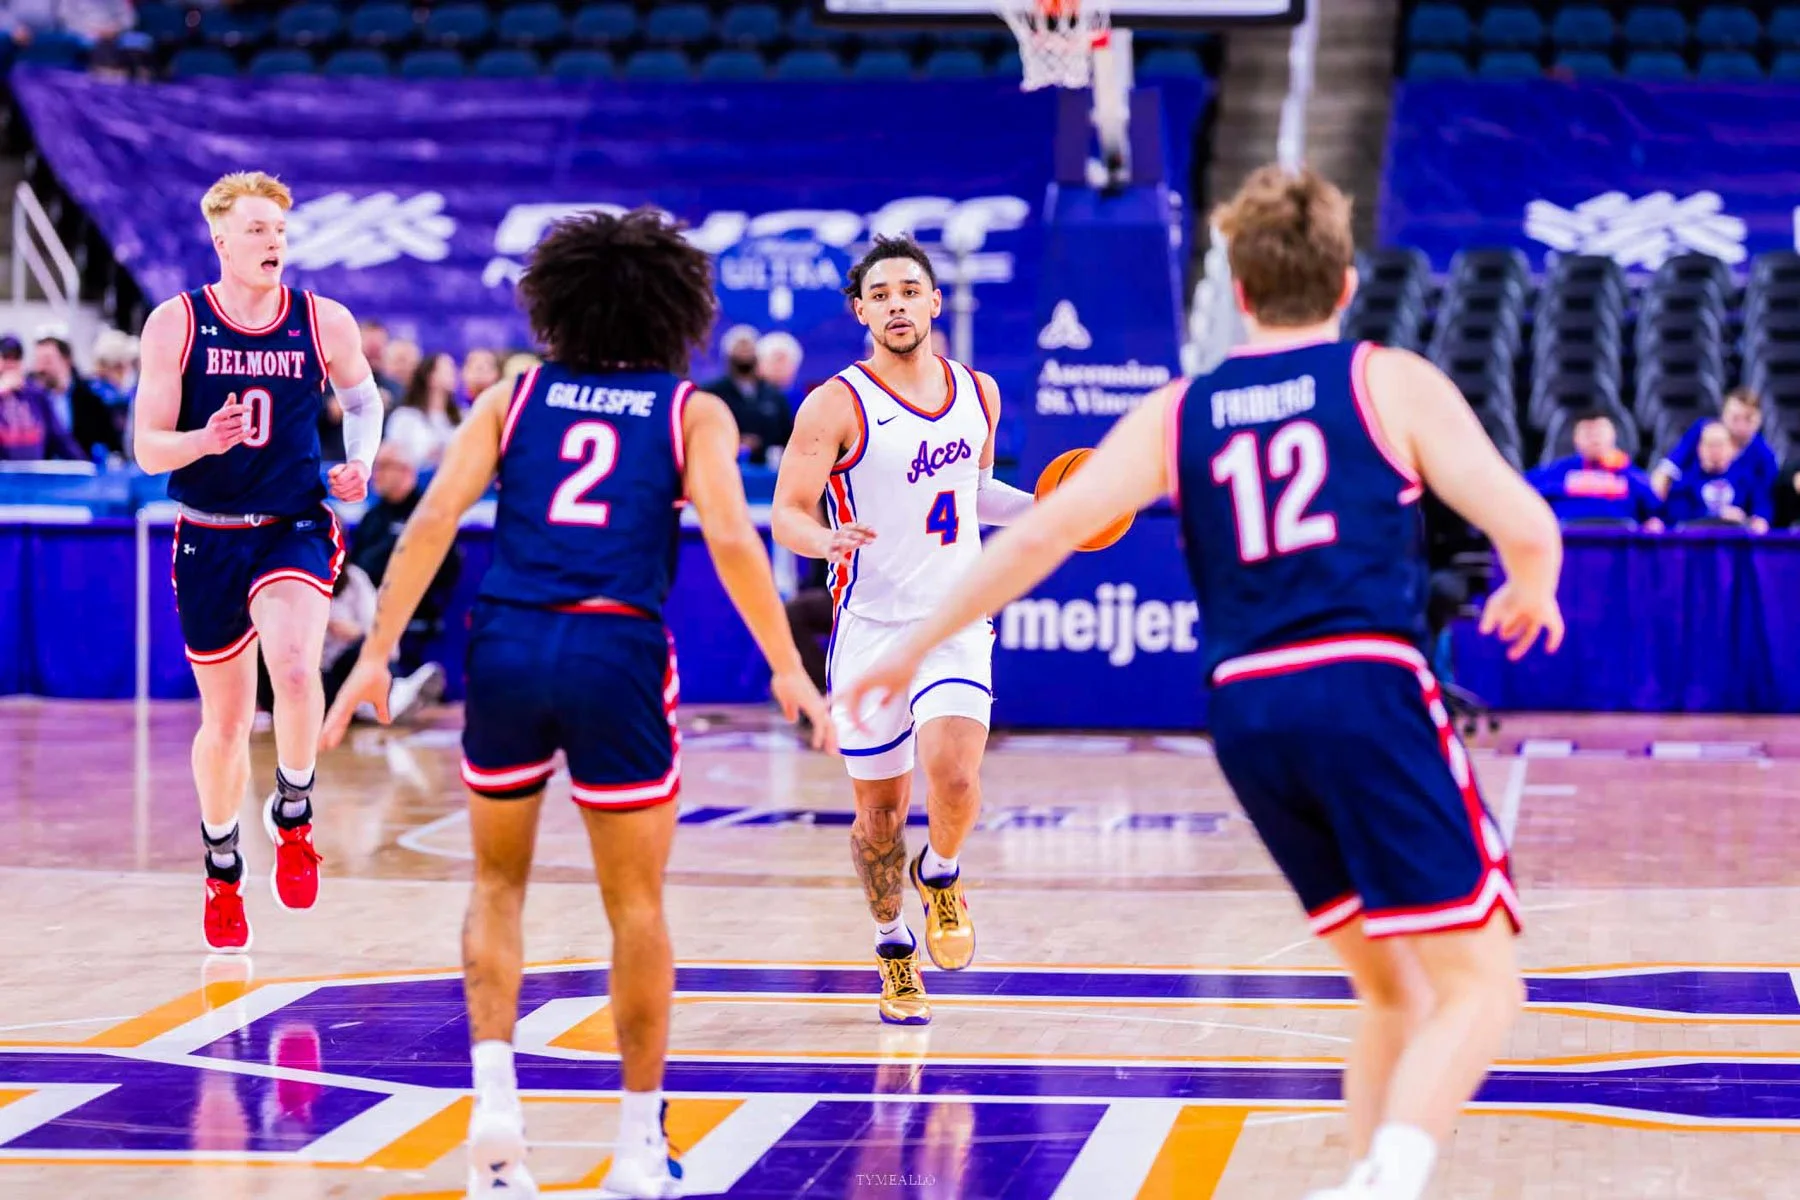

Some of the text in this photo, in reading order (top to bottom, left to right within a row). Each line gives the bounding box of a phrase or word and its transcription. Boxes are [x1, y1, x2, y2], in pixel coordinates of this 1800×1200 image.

[206, 347, 305, 379] BELMONT
[241, 387, 272, 448] 0
[546, 382, 656, 417] GILLESPIE
[548, 419, 620, 528] 2
[907, 438, 971, 484] Aces
[926, 490, 959, 546] 4
[1210, 420, 1338, 564] 12
[1001, 582, 1199, 667] meijer
